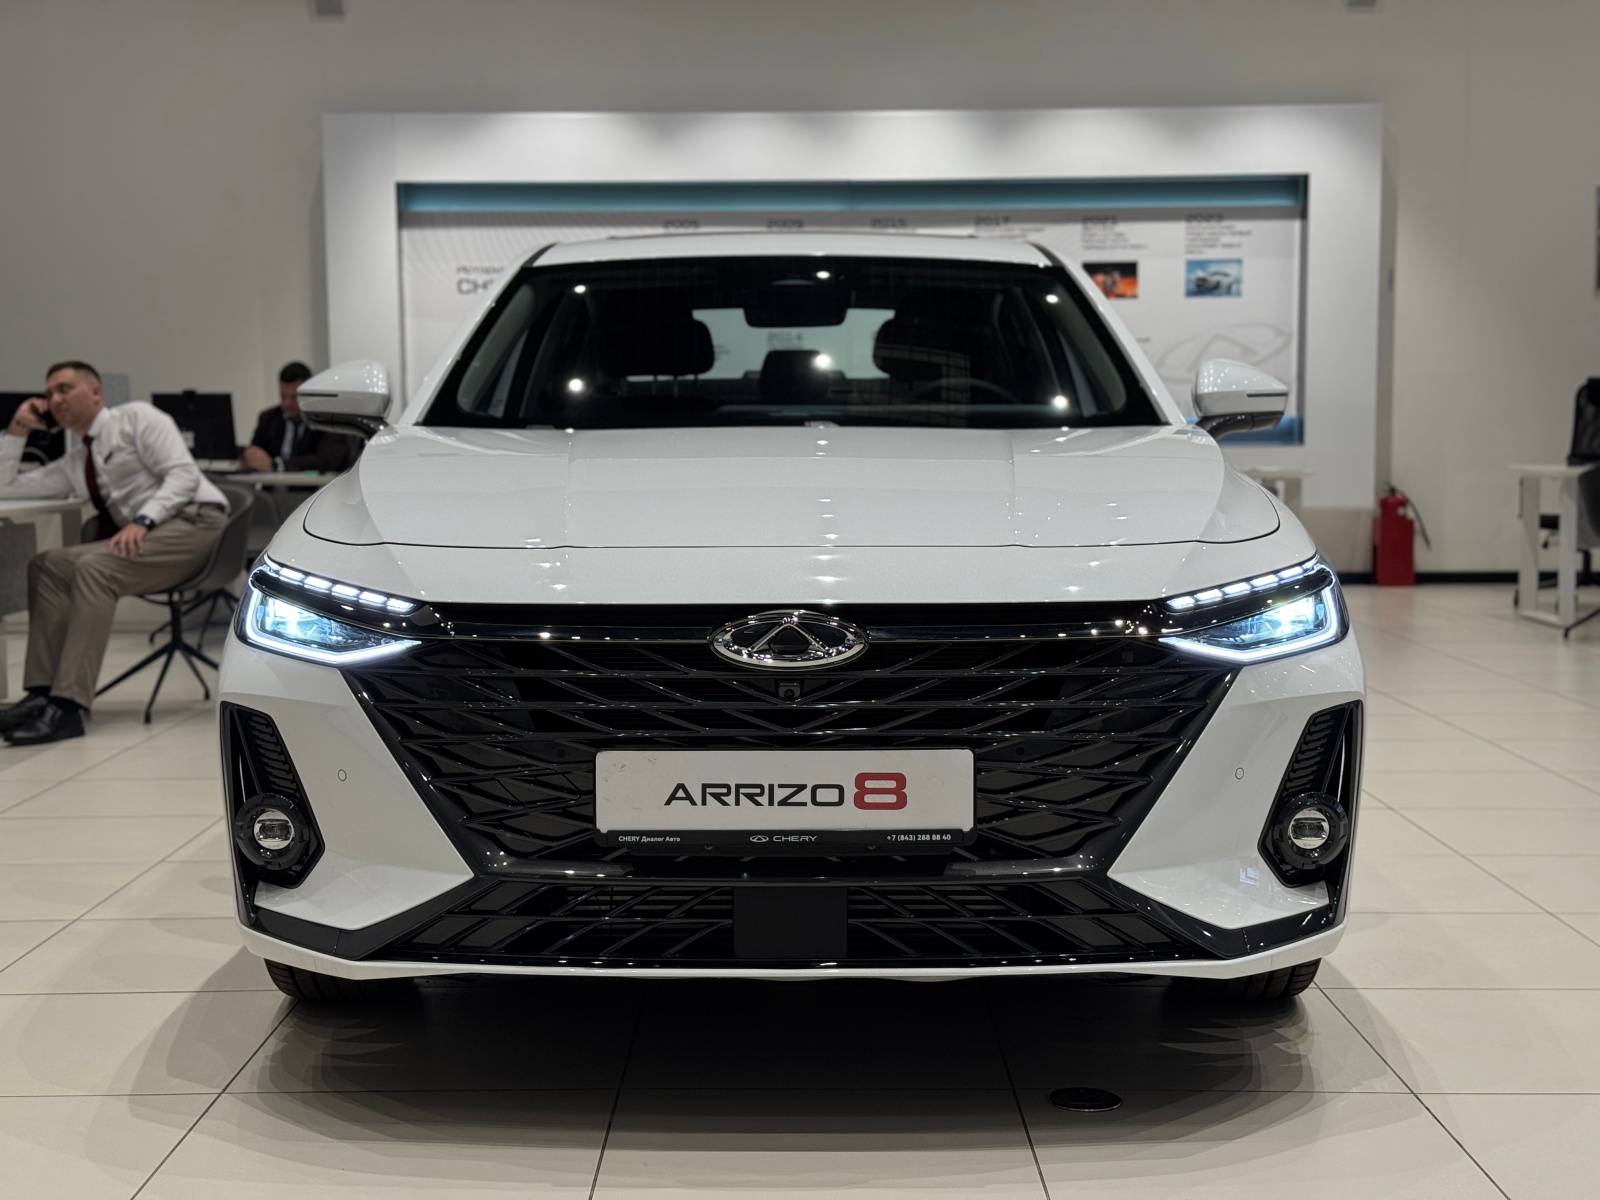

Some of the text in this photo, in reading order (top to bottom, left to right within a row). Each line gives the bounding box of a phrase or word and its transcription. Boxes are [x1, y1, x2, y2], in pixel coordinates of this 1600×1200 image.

[664, 772, 908, 811] ARRIZO 8
[641, 835, 664, 843] Диалог
[897, 834, 916, 842] (843)
